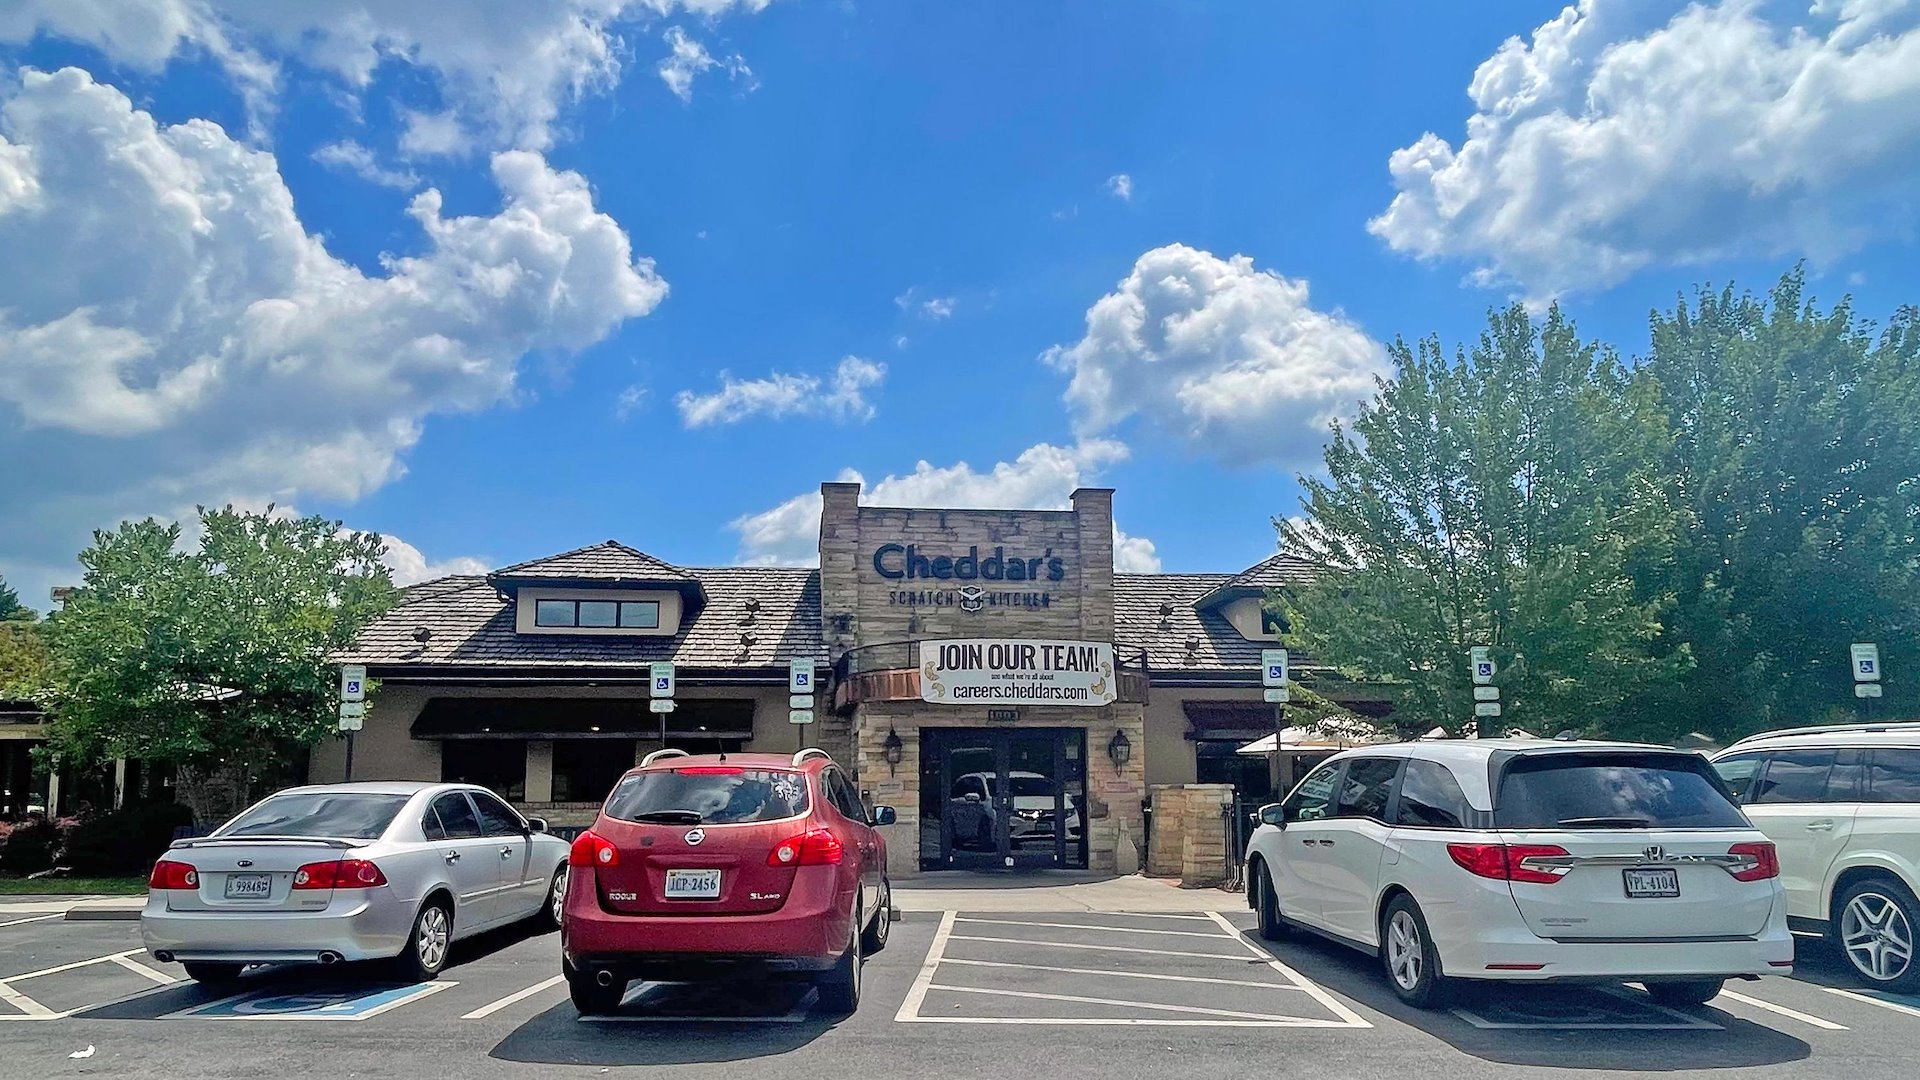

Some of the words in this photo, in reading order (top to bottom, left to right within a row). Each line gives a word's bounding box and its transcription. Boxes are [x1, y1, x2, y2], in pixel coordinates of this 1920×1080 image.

[873, 543, 1065, 581] Cheddar's
[889, 591, 953, 607] SCRATCH
[990, 591, 1050, 608] KITCHEN
[937, 644, 982, 671] JOIN
[988, 644, 1035, 671] OUR
[1041, 645, 1100, 673] TEAM!
[953, 682, 1088, 700] careers.cheddars.com
